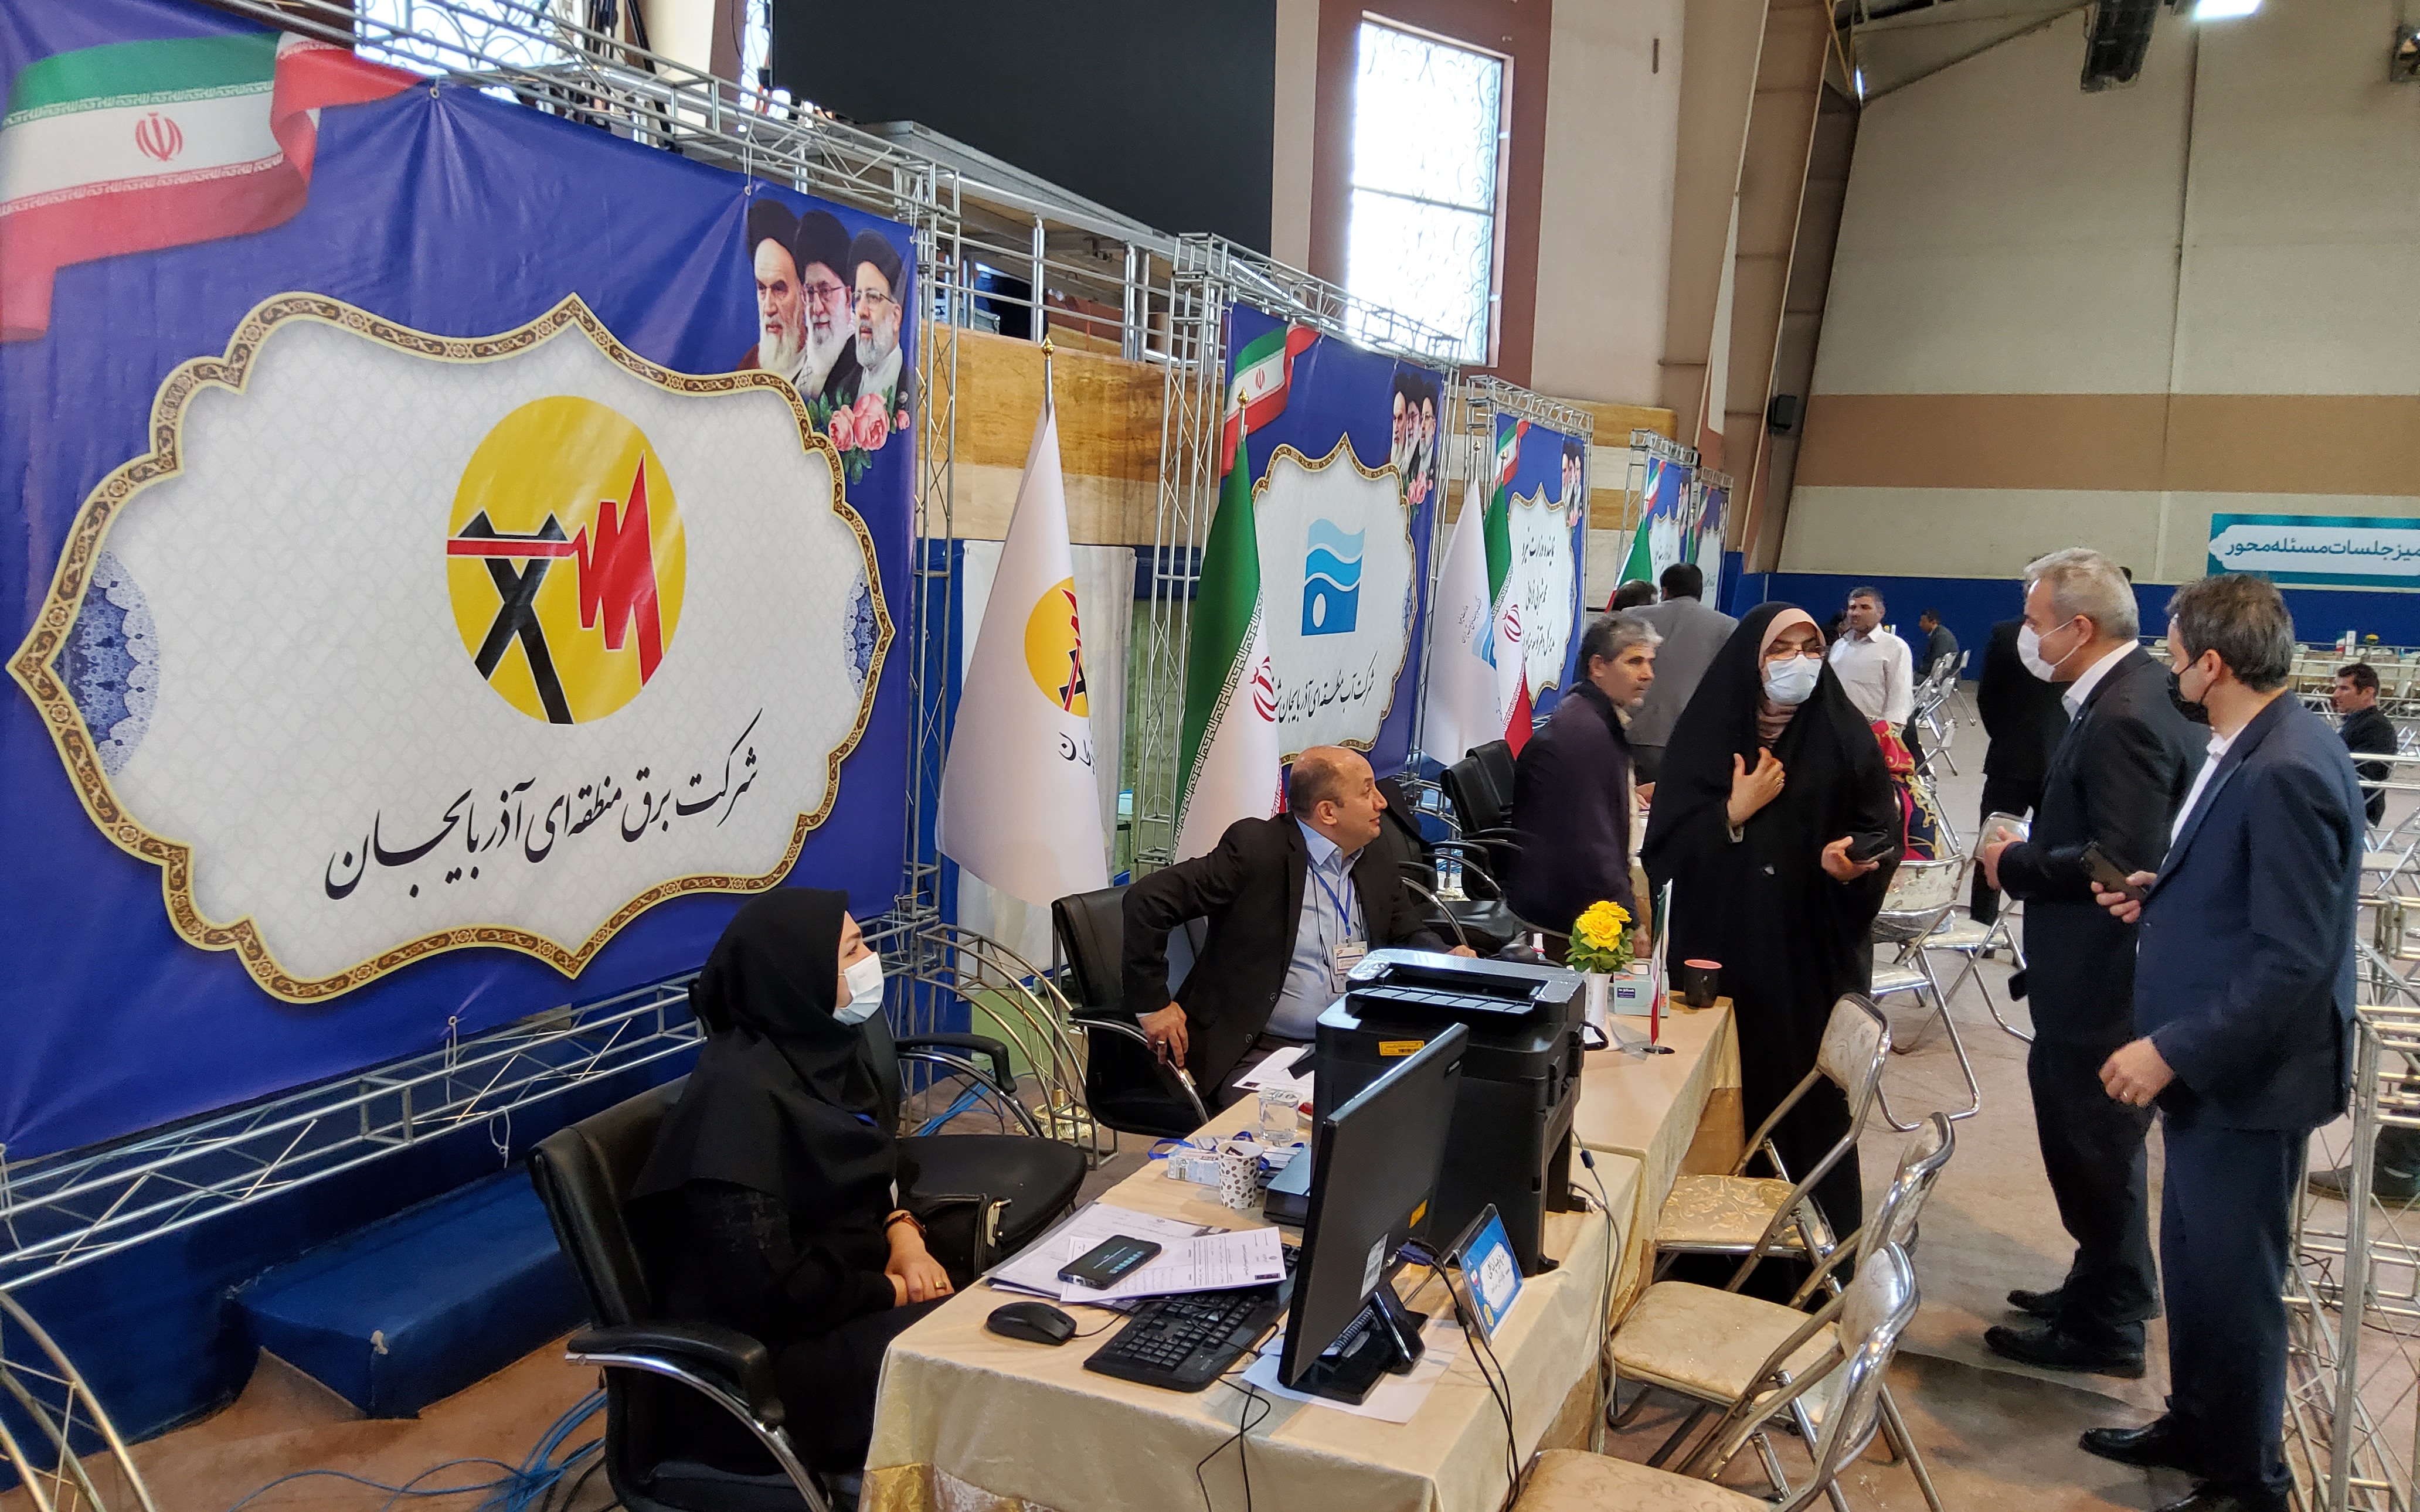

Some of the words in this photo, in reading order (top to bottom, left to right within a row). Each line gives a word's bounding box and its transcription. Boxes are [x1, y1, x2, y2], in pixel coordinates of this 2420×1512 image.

[2225, 542, 2271, 556] محور
[2271, 537, 2328, 553] مسئله
[2329, 539, 2394, 561] جلسات
[1278, 678, 1314, 724] آذربایجان
[1340, 672, 1358, 714] آب
[1353, 649, 1378, 707] شرکت
[675, 707, 763, 828] شرکت
[621, 767, 671, 843] برق
[325, 776, 536, 900] آذربایجان
